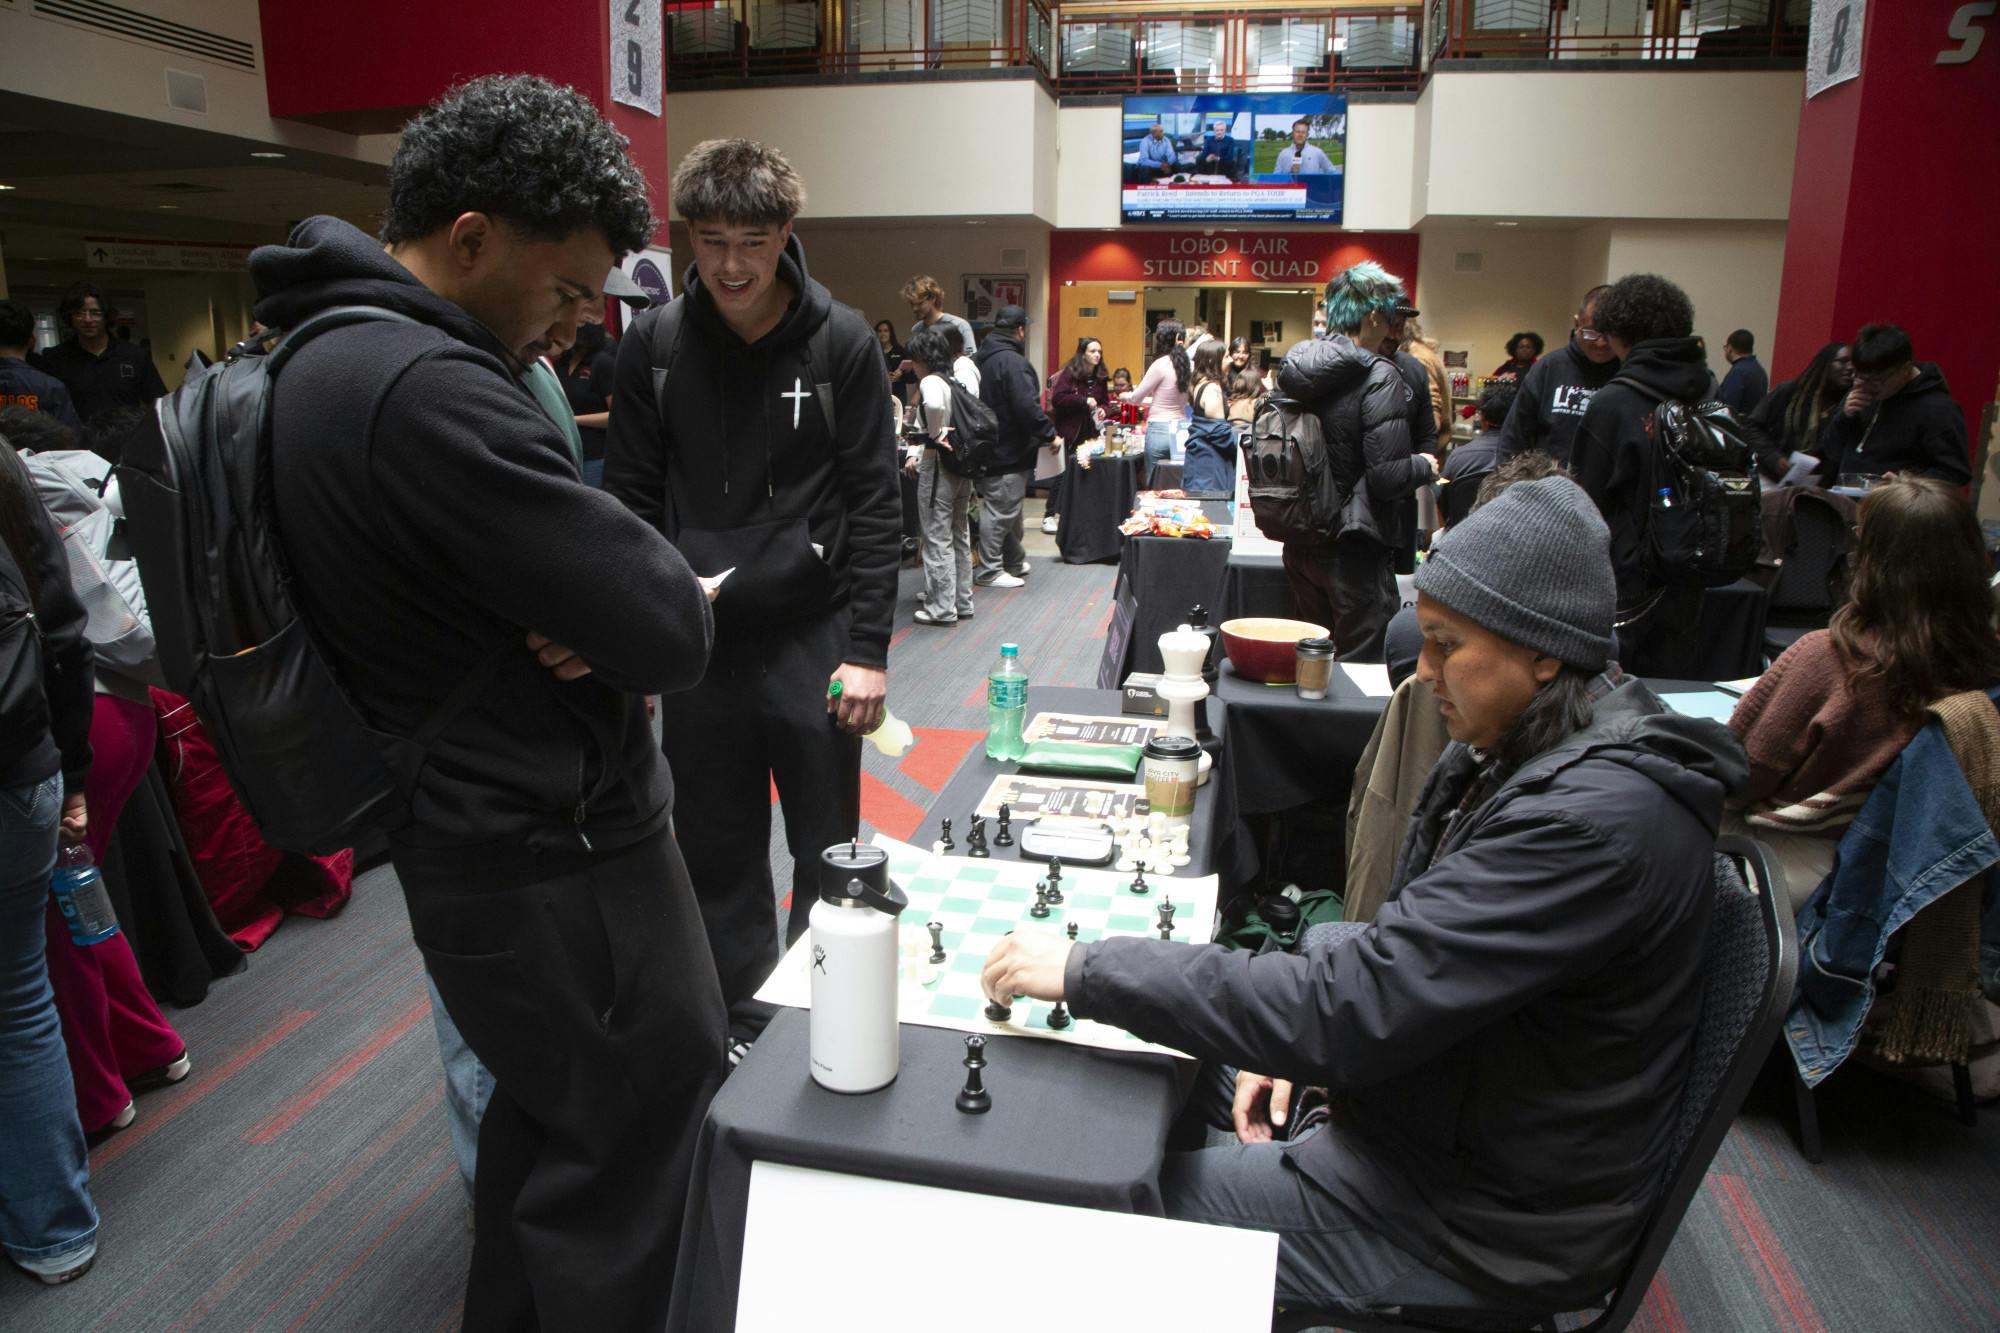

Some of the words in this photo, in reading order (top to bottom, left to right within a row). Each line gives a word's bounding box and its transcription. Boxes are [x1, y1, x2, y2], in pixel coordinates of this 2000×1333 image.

[1935, 2, 1997, 65] S
[1137, 190, 1160, 198] Patrick
[1162, 190, 1178, 198] Reed
[1185, 190, 1210, 198] Intends
[1211, 190, 1218, 198] to
[1219, 190, 1242, 198] Return
[1243, 190, 1250, 198] to
[1251, 190, 1265, 198] PGA
[1267, 190, 1285, 198] TOUR
[1170, 237, 1229, 254] LOBO
[1239, 237, 1289, 254] LAIR
[1143, 259, 1241, 277] STUDENT
[1251, 260, 1320, 280] QUAD
